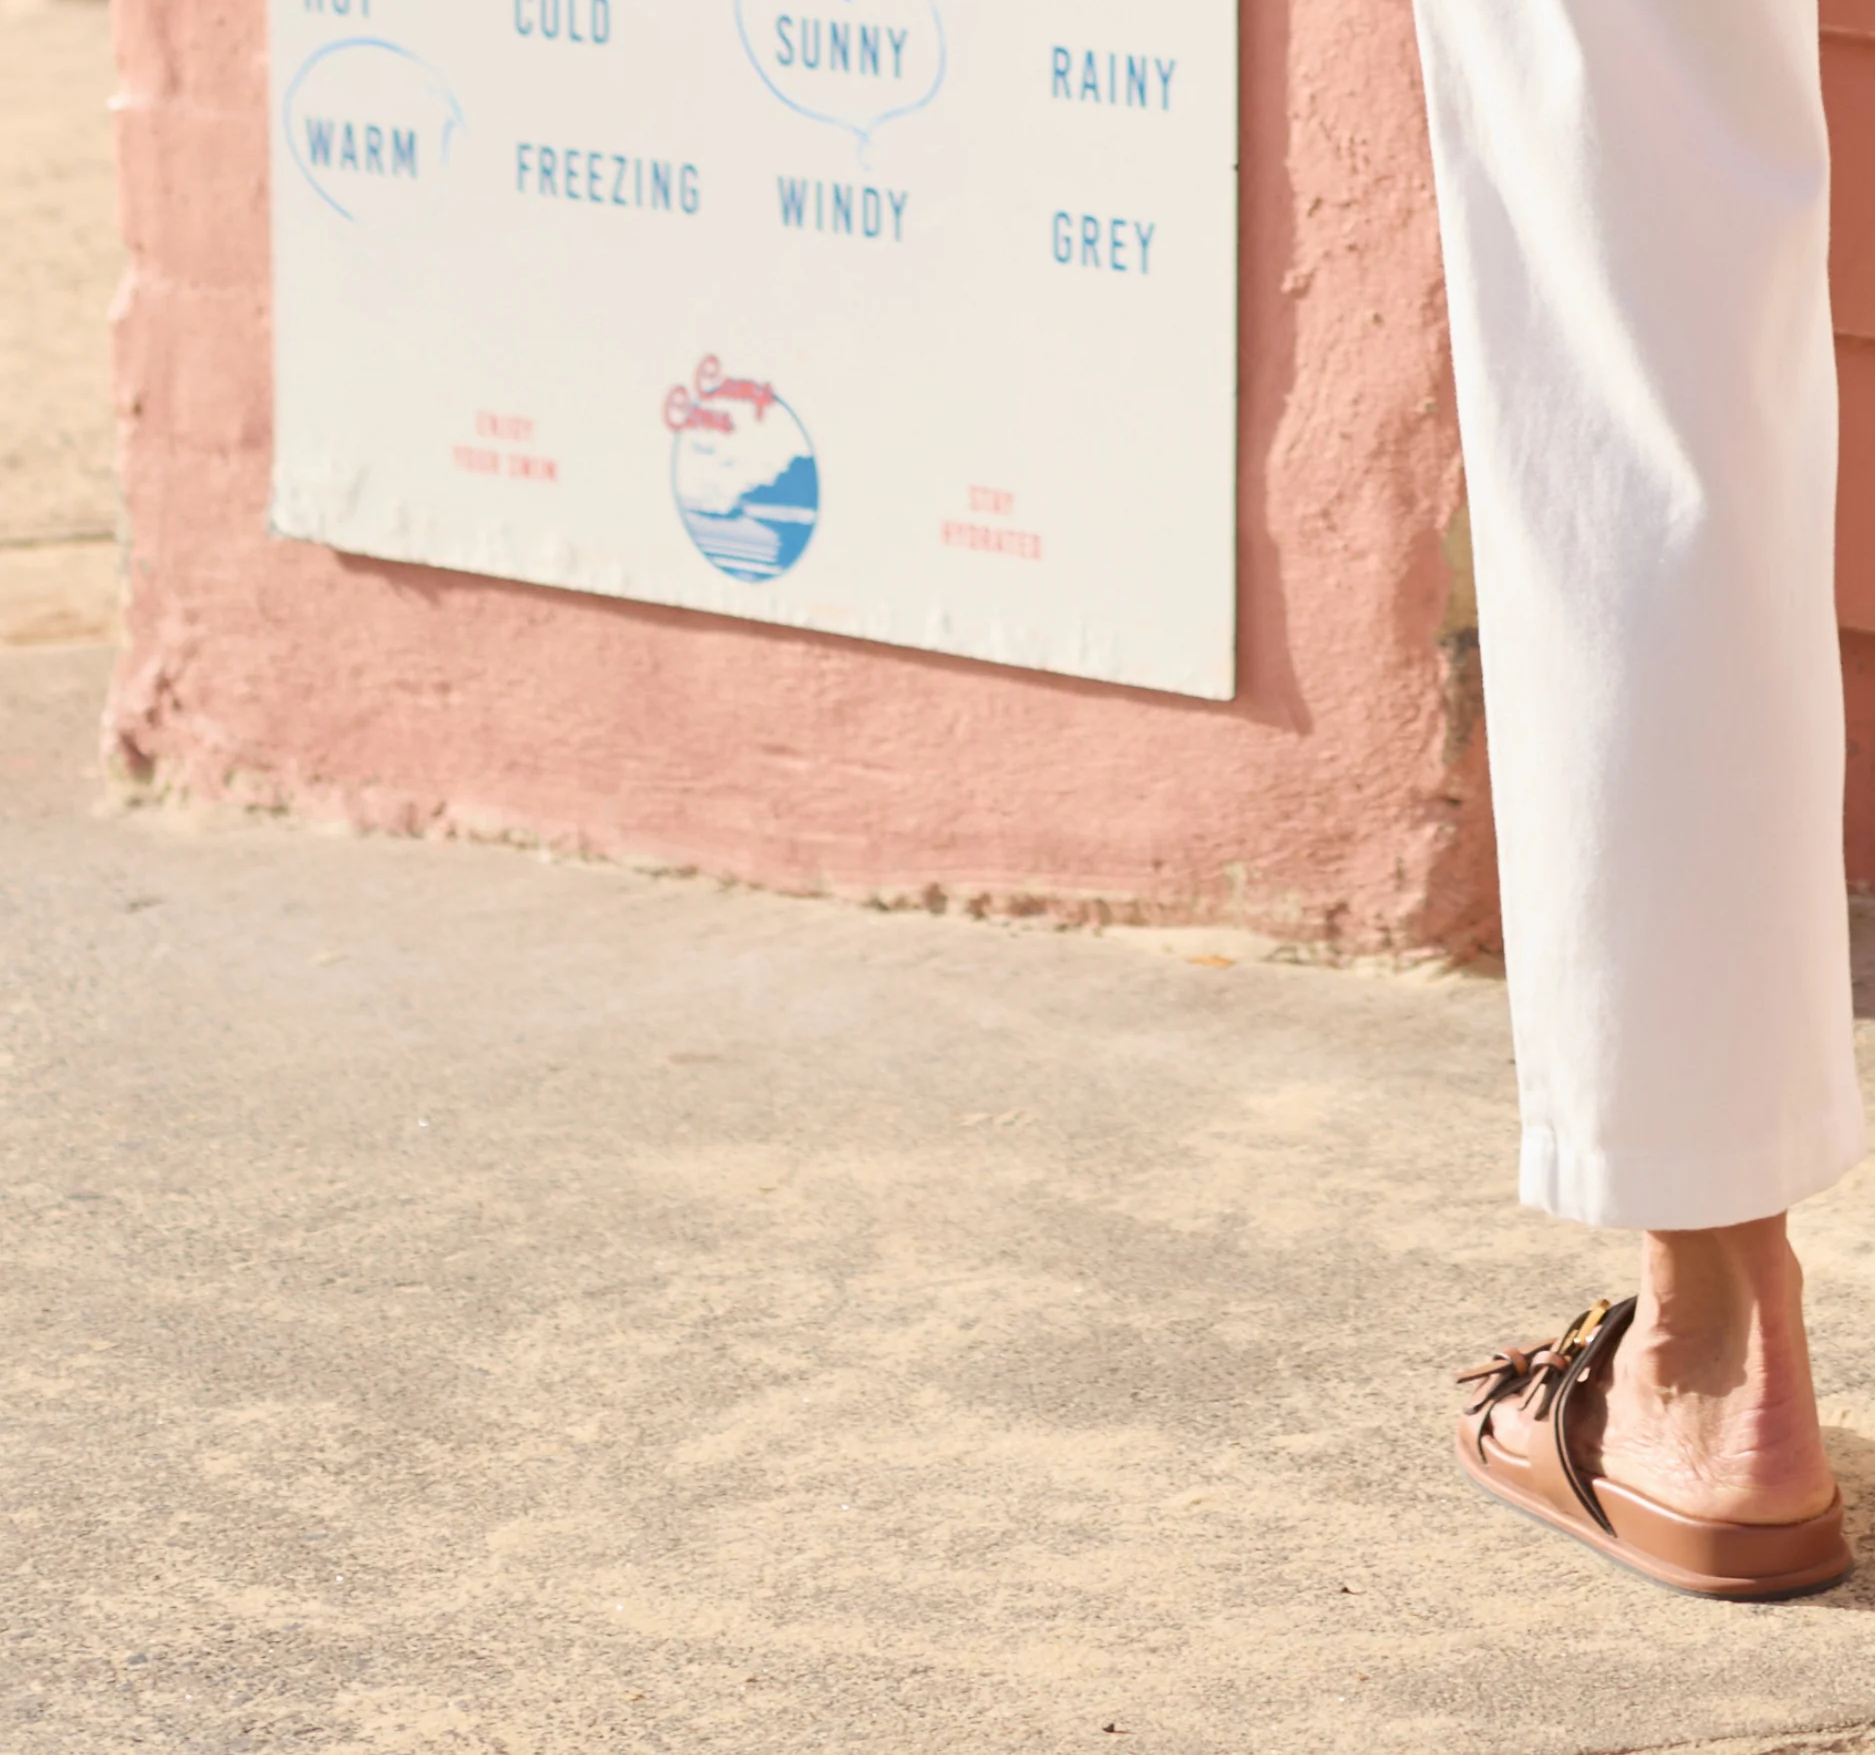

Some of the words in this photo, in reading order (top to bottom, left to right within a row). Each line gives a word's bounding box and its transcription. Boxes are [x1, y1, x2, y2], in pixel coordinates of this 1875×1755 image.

[773, 14, 910, 81] SUNNY
[1051, 47, 1178, 112] RAINY
[304, 116, 420, 180] WARM
[515, 143, 703, 216] FREEZING
[776, 175, 910, 243] WINDY
[1051, 210, 1157, 276] GREY
